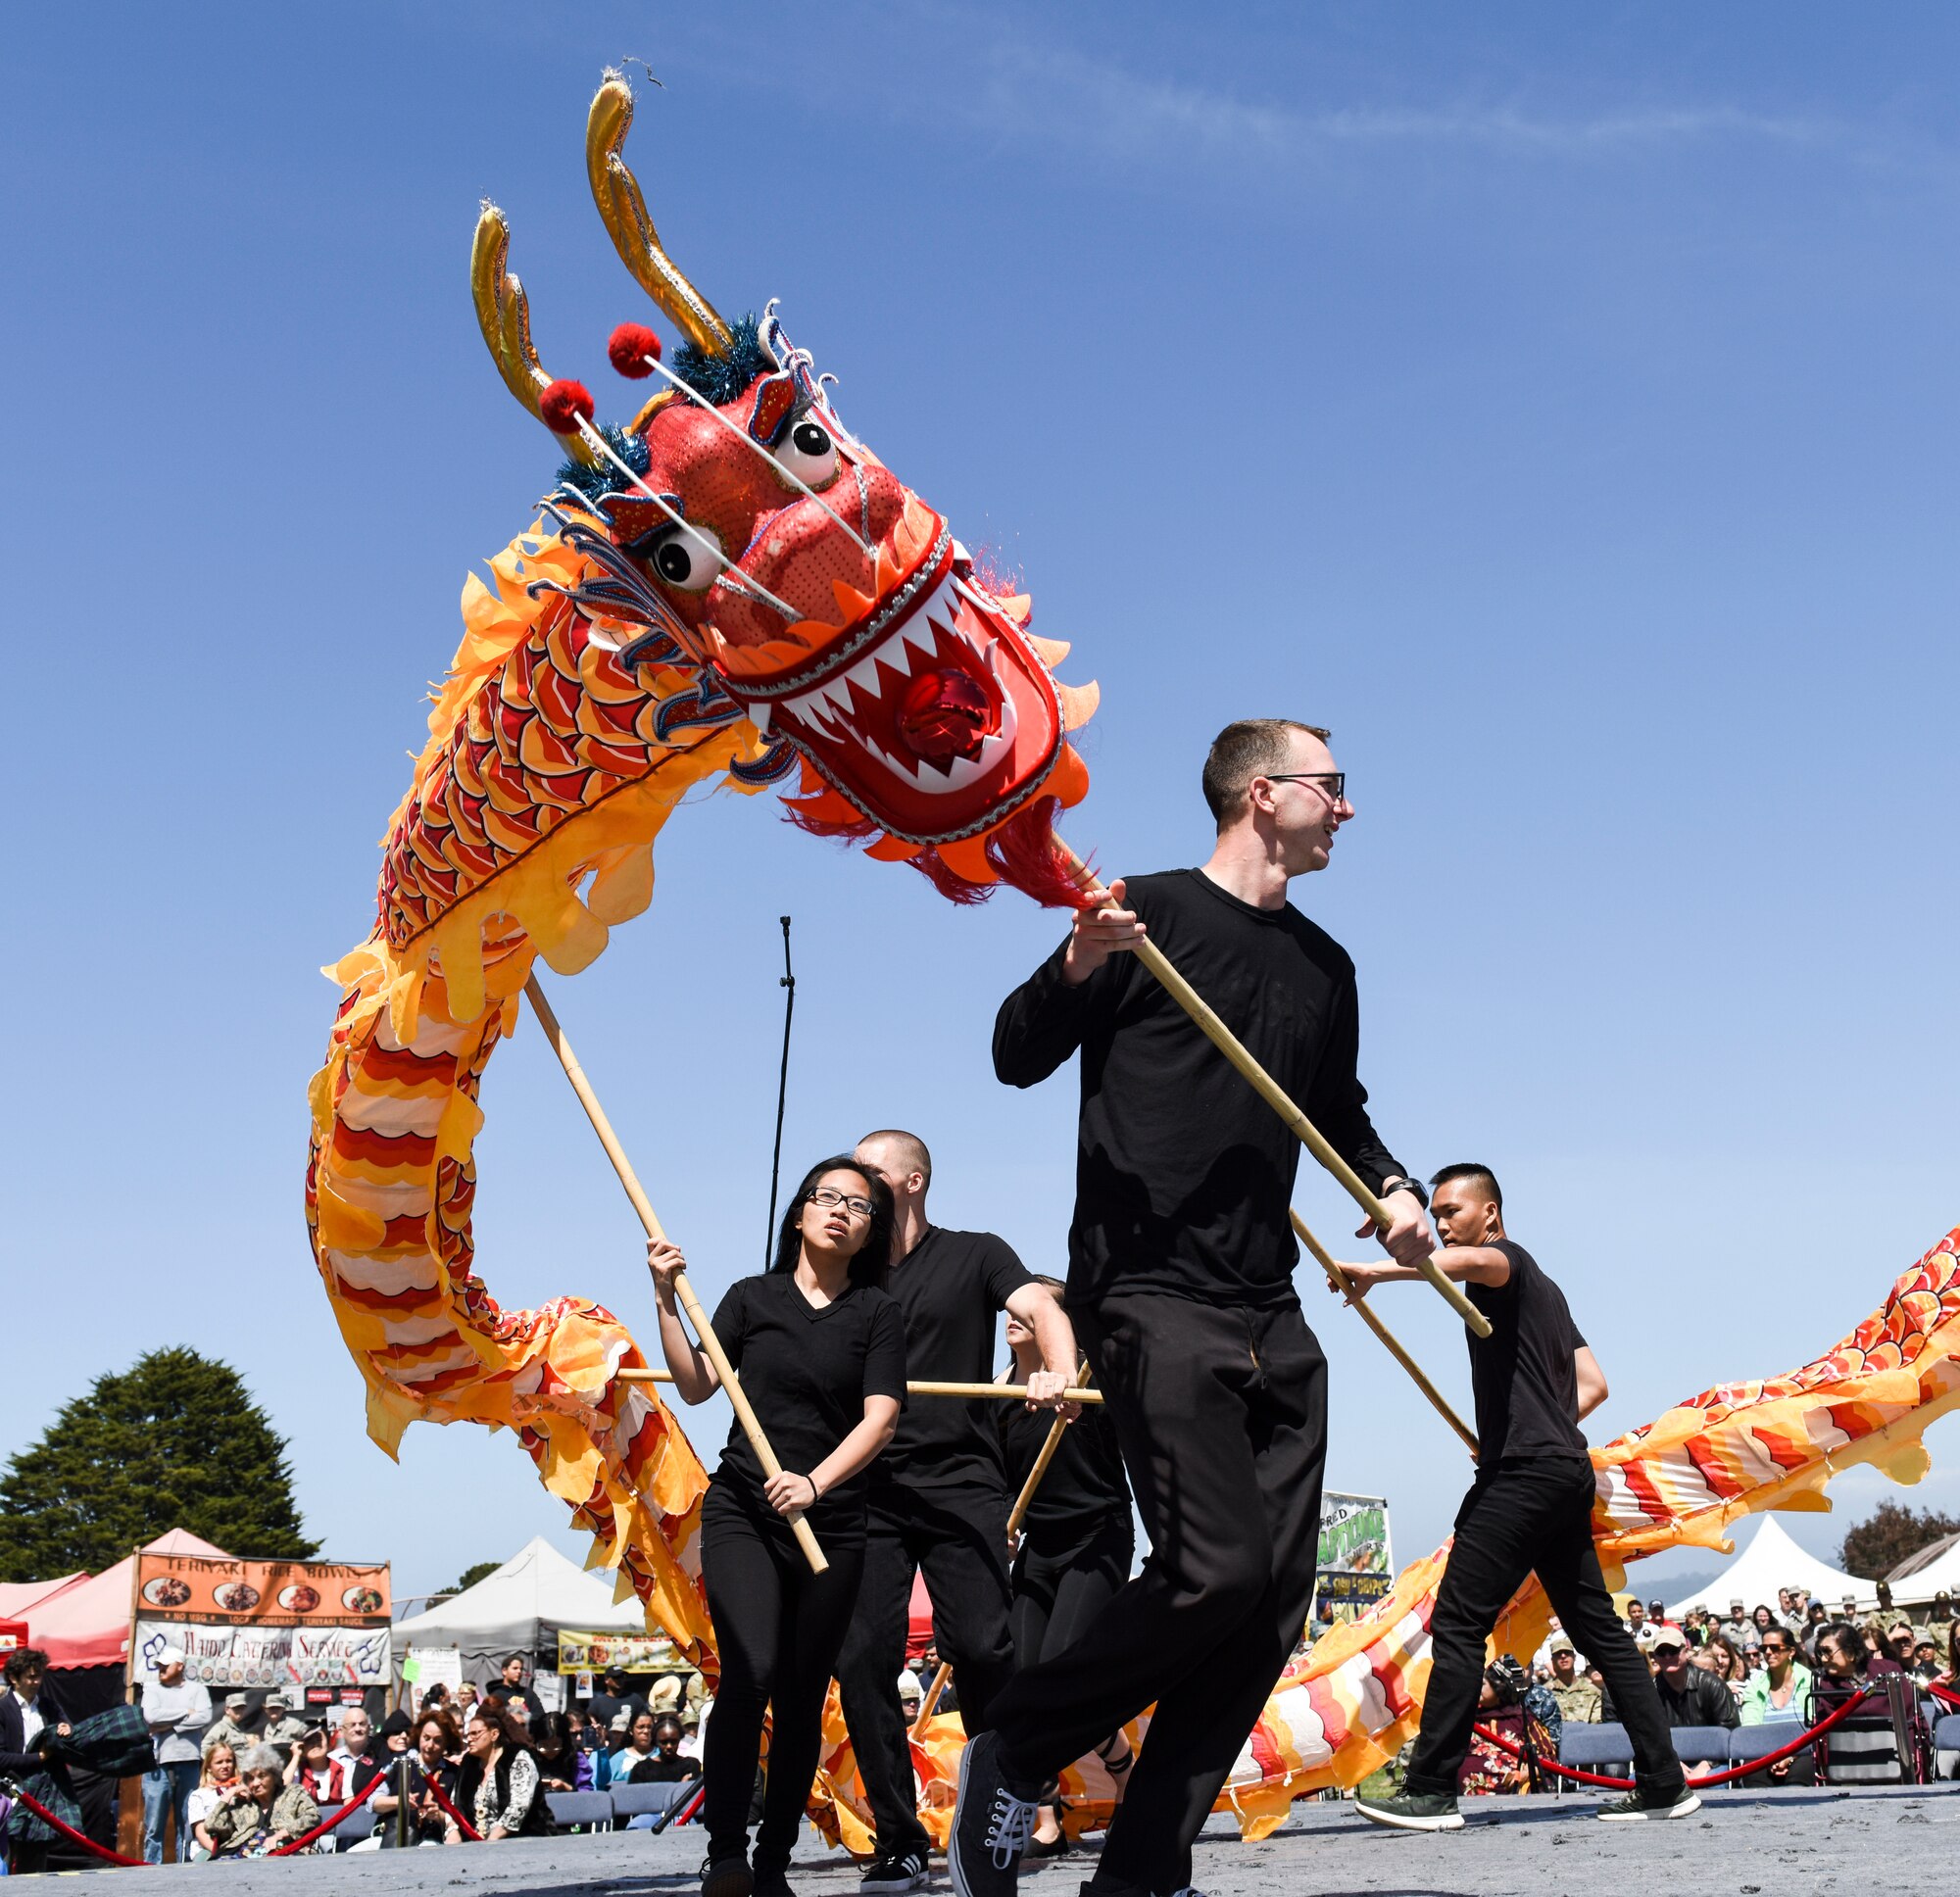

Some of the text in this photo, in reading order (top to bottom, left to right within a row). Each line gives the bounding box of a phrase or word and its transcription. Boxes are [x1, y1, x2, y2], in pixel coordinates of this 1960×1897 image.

[167, 1558, 246, 1576] TERIYAKI
[262, 1565, 295, 1577] RICE
[173, 1613, 186, 1622] NO
[189, 1614, 207, 1623] MSG
[228, 1616, 250, 1625] LOCA
